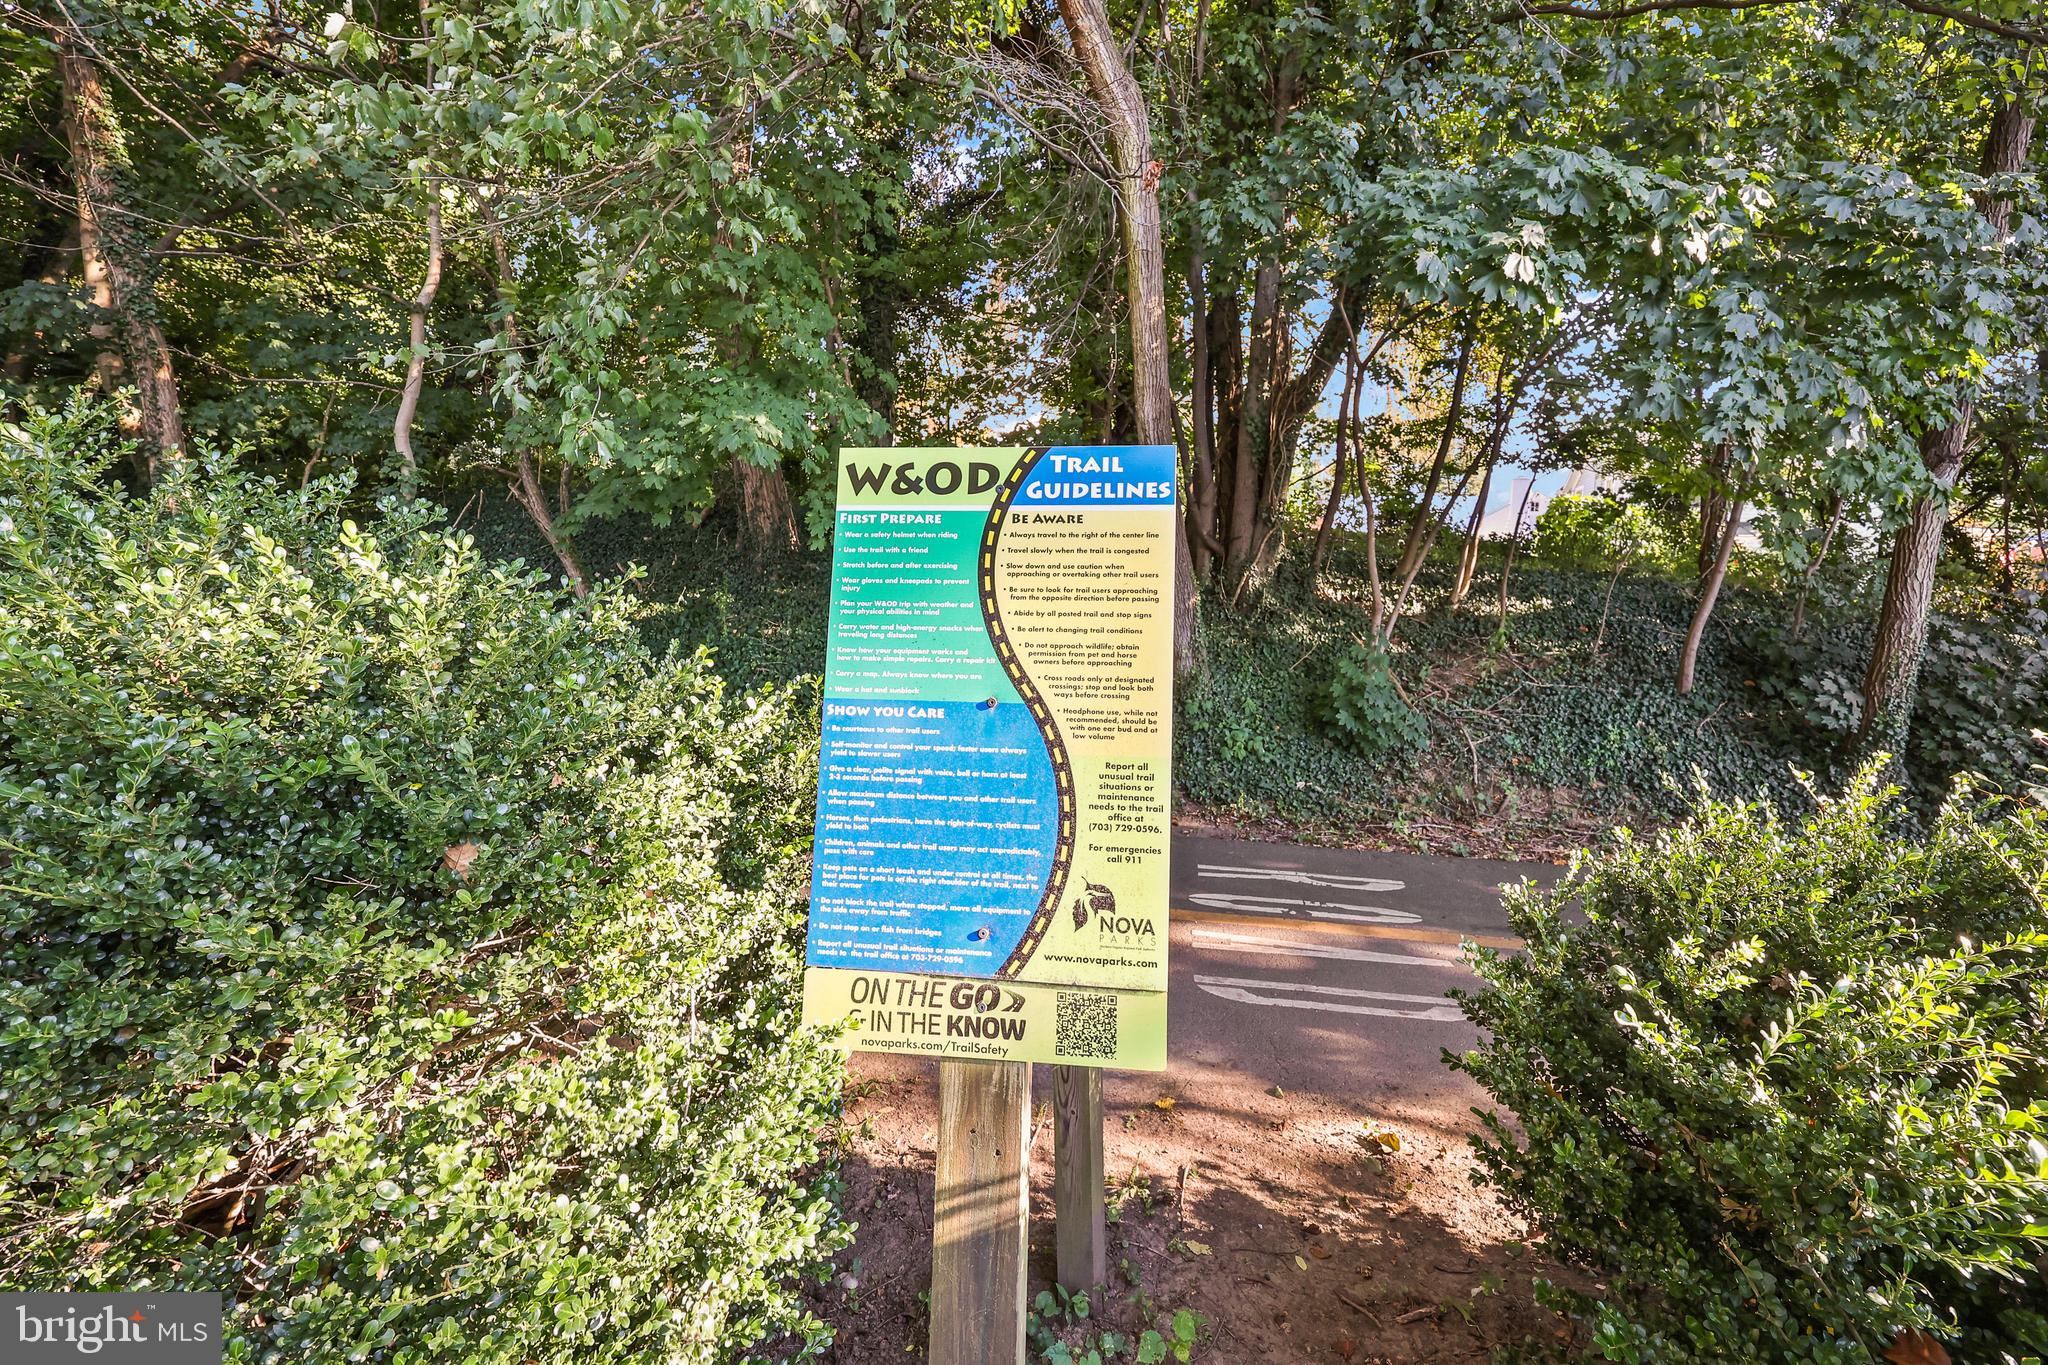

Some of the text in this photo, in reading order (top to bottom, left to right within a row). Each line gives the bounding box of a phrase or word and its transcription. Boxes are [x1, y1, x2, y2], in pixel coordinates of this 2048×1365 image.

[1050, 455, 1124, 473] TRAIL
[846, 462, 1000, 496] W&OD
[1026, 481, 1171, 499] GUIDELINES
[840, 513, 942, 524] FIRST PREPARE
[1012, 514, 1084, 524] BE AWARE
[827, 704, 945, 718] SHOW YOU CARE
[1063, 708, 1104, 716] Headphone
[1105, 762, 1134, 772] Report
[1098, 772, 1154, 781] unusual trail
[1099, 782, 1142, 791] situations
[1097, 792, 1154, 801] maintenance
[1088, 802, 1114, 811] needs
[1145, 804, 1163, 812] trail
[1107, 813, 1131, 822] office
[1088, 823, 1162, 833] (703) 729-0596.
[1105, 844, 1161, 855] emergencies
[1125, 856, 1141, 864] 911
[843, 924, 859, 932] stop
[914, 928, 941, 937] bridges
[1100, 916, 1155, 935] NOVA
[1100, 934, 1156, 946] PARKS
[1044, 954, 1158, 968] www.novaparks.com
[850, 976, 1001, 1012] ON THE GO
[870, 1010, 892, 1032] IN
[897, 1011, 941, 1035] THE
[947, 1015, 1026, 1041] KNOW
[861, 1038, 1008, 1057] novaparks.com/TrailSafety
